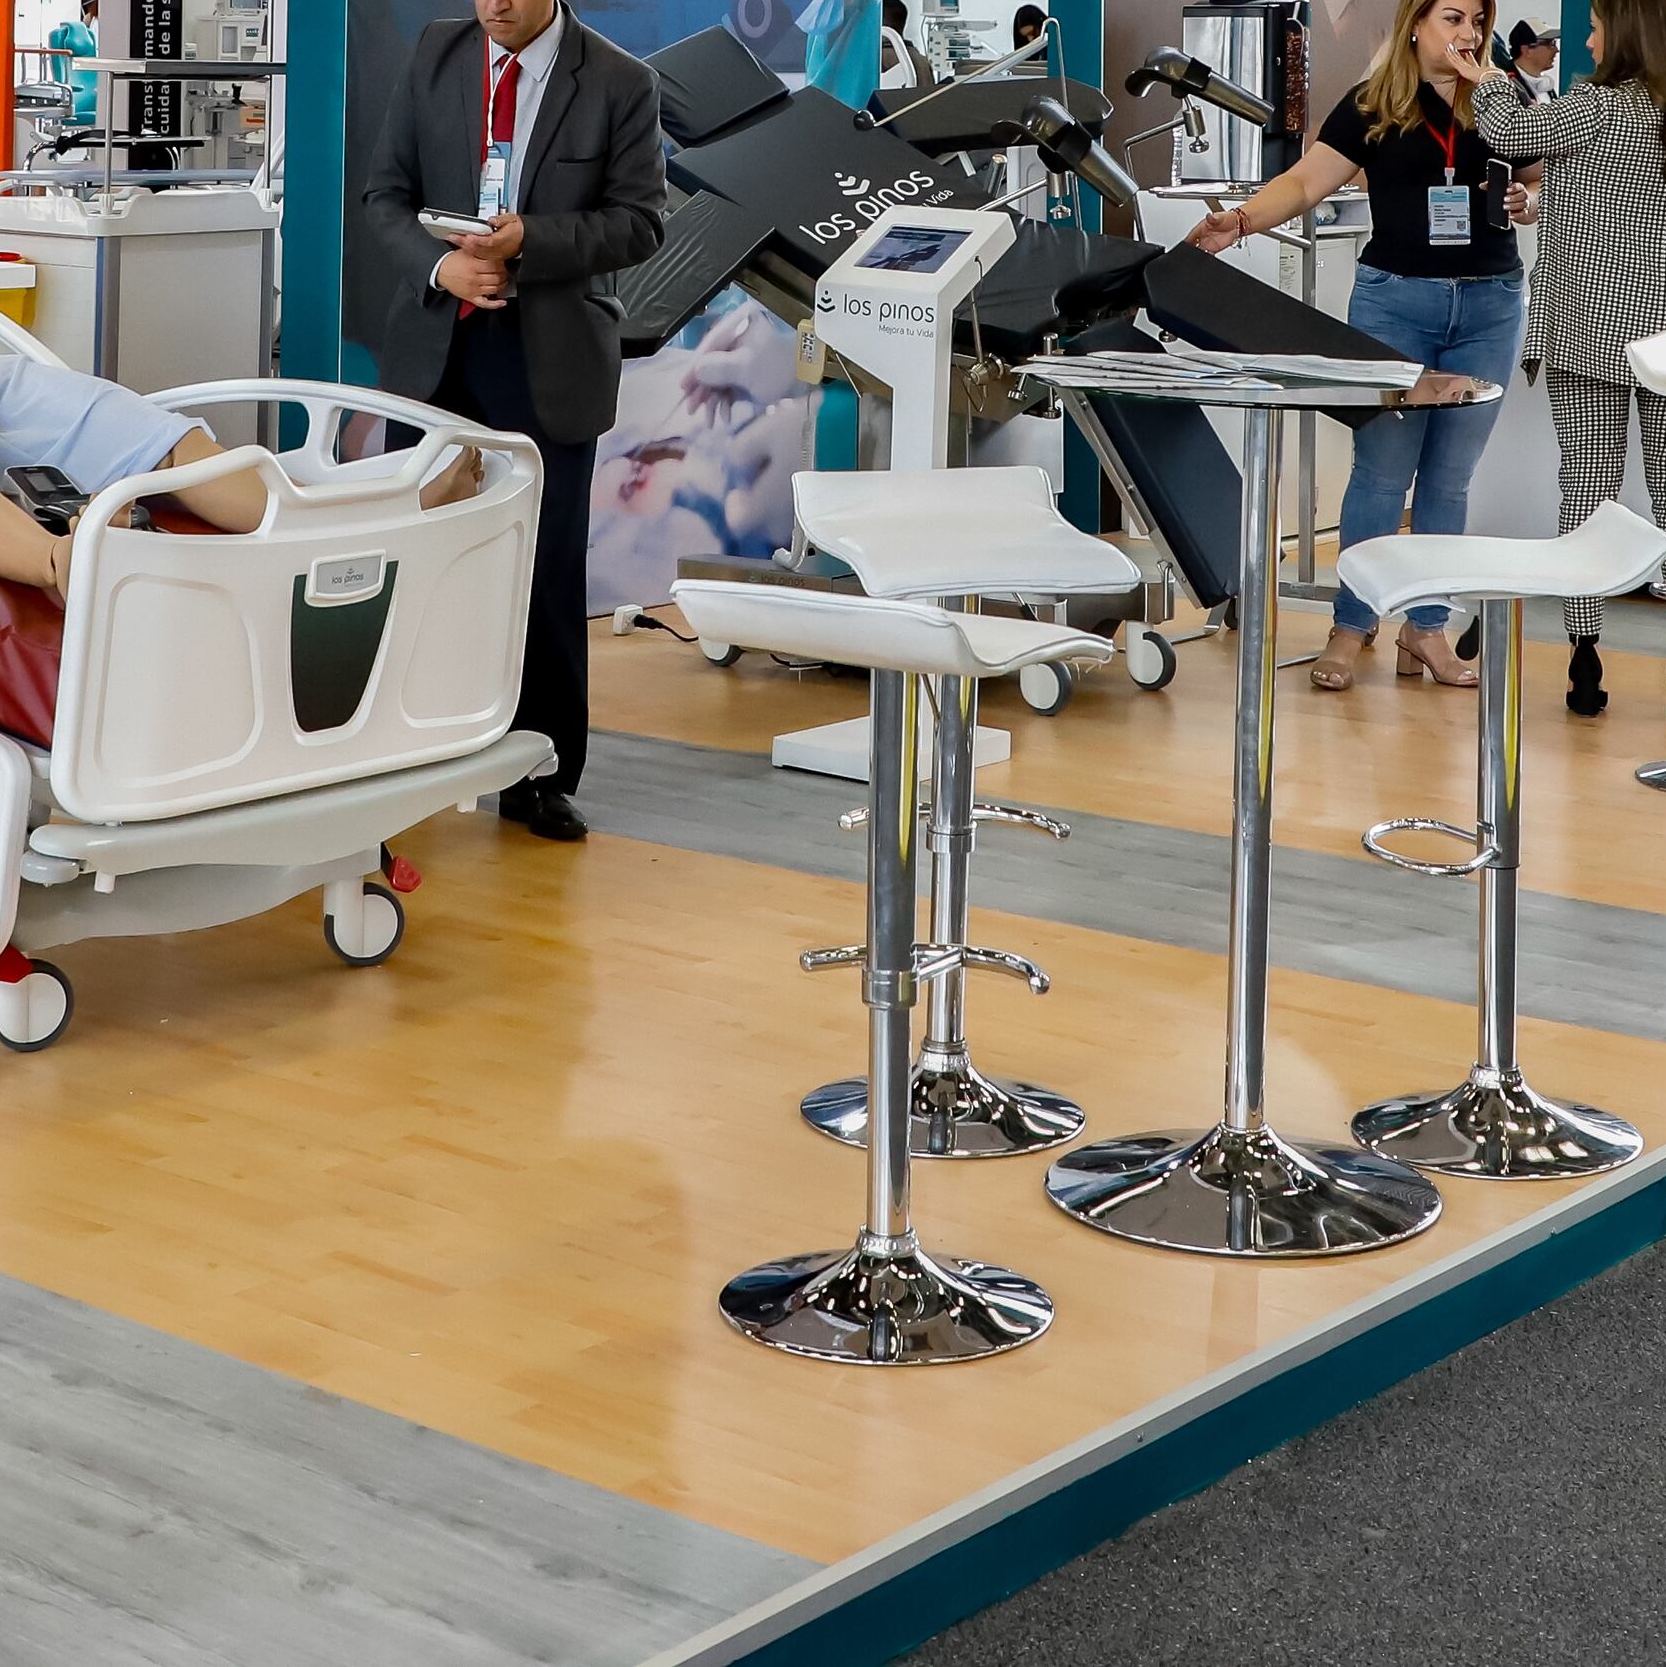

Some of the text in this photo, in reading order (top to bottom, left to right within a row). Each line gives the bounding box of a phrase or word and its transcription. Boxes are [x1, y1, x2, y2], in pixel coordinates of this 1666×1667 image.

[159, 13, 171, 27] la
[158, 32, 171, 55] de
[799, 170, 935, 245] los pinos
[844, 293, 935, 323] los pinos
[878, 324, 934, 339] Mejora tu Vida
